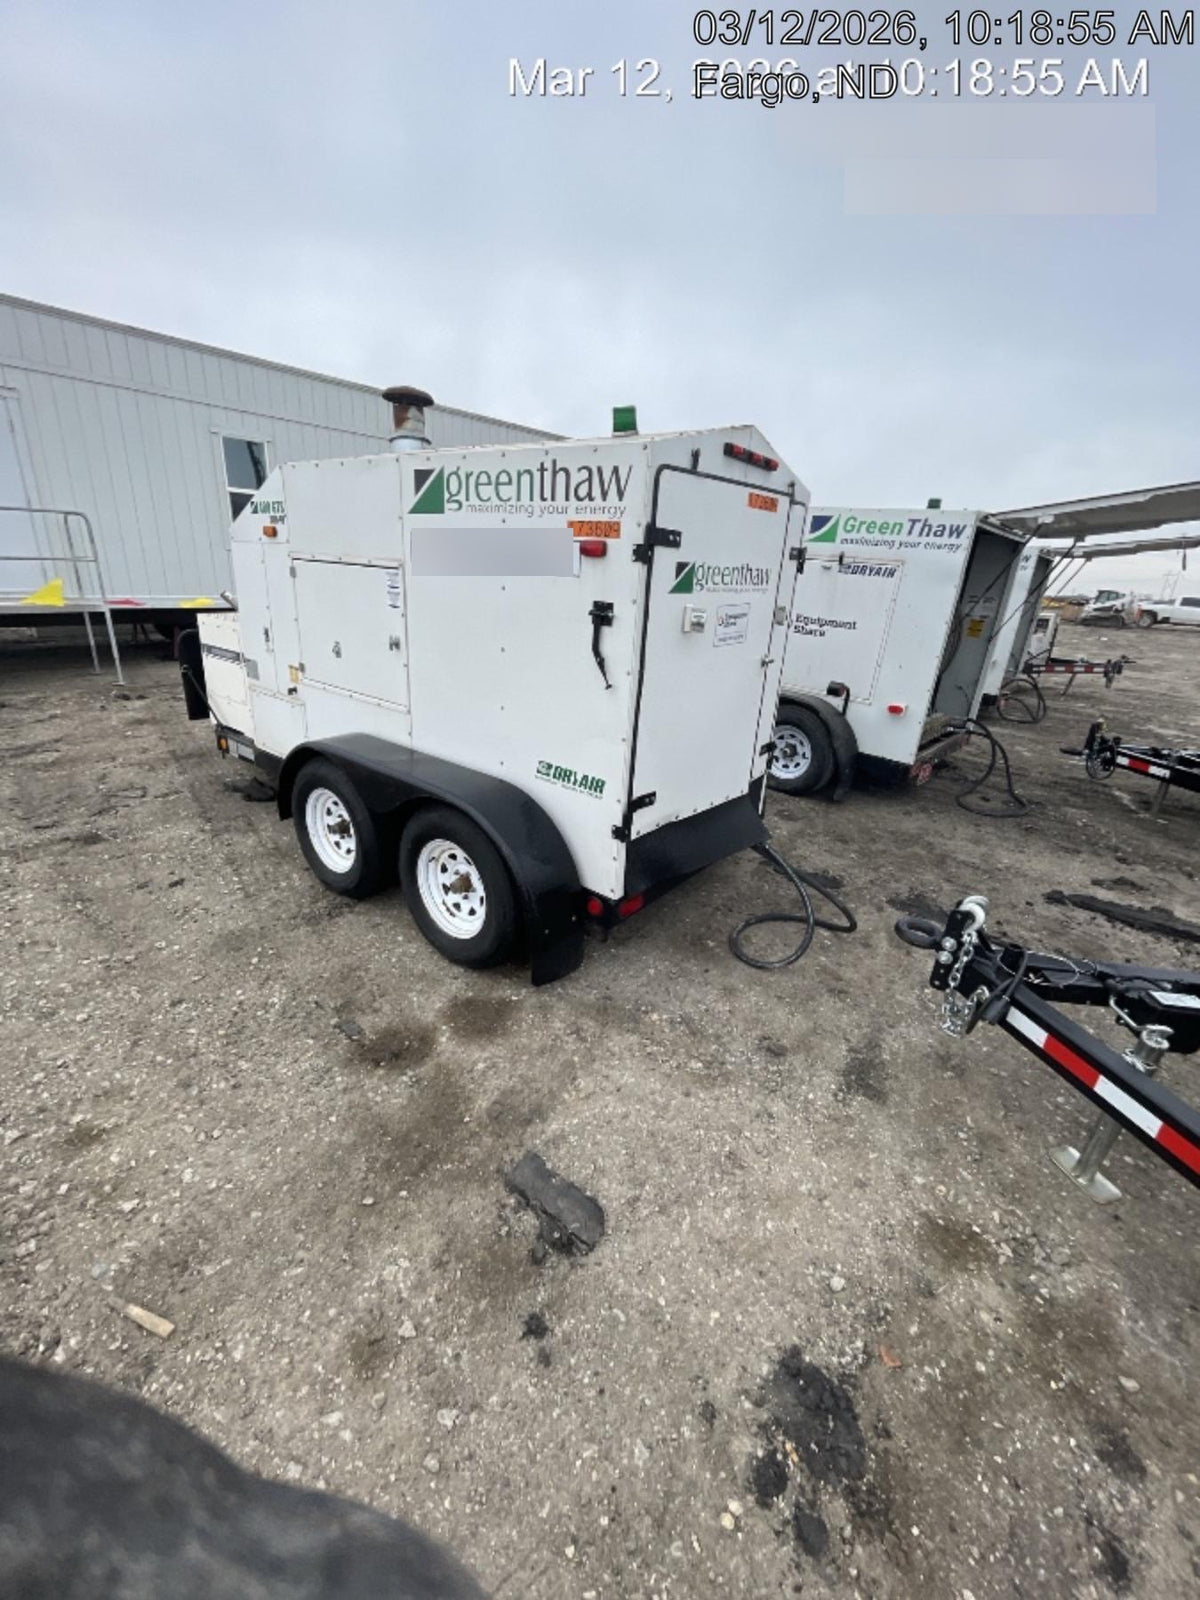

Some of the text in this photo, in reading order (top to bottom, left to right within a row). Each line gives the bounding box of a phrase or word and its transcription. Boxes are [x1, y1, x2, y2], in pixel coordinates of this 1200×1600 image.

[445, 458, 634, 512] greenthaw
[466, 501, 627, 520] maximizing your energy
[899, 539, 922, 549] your
